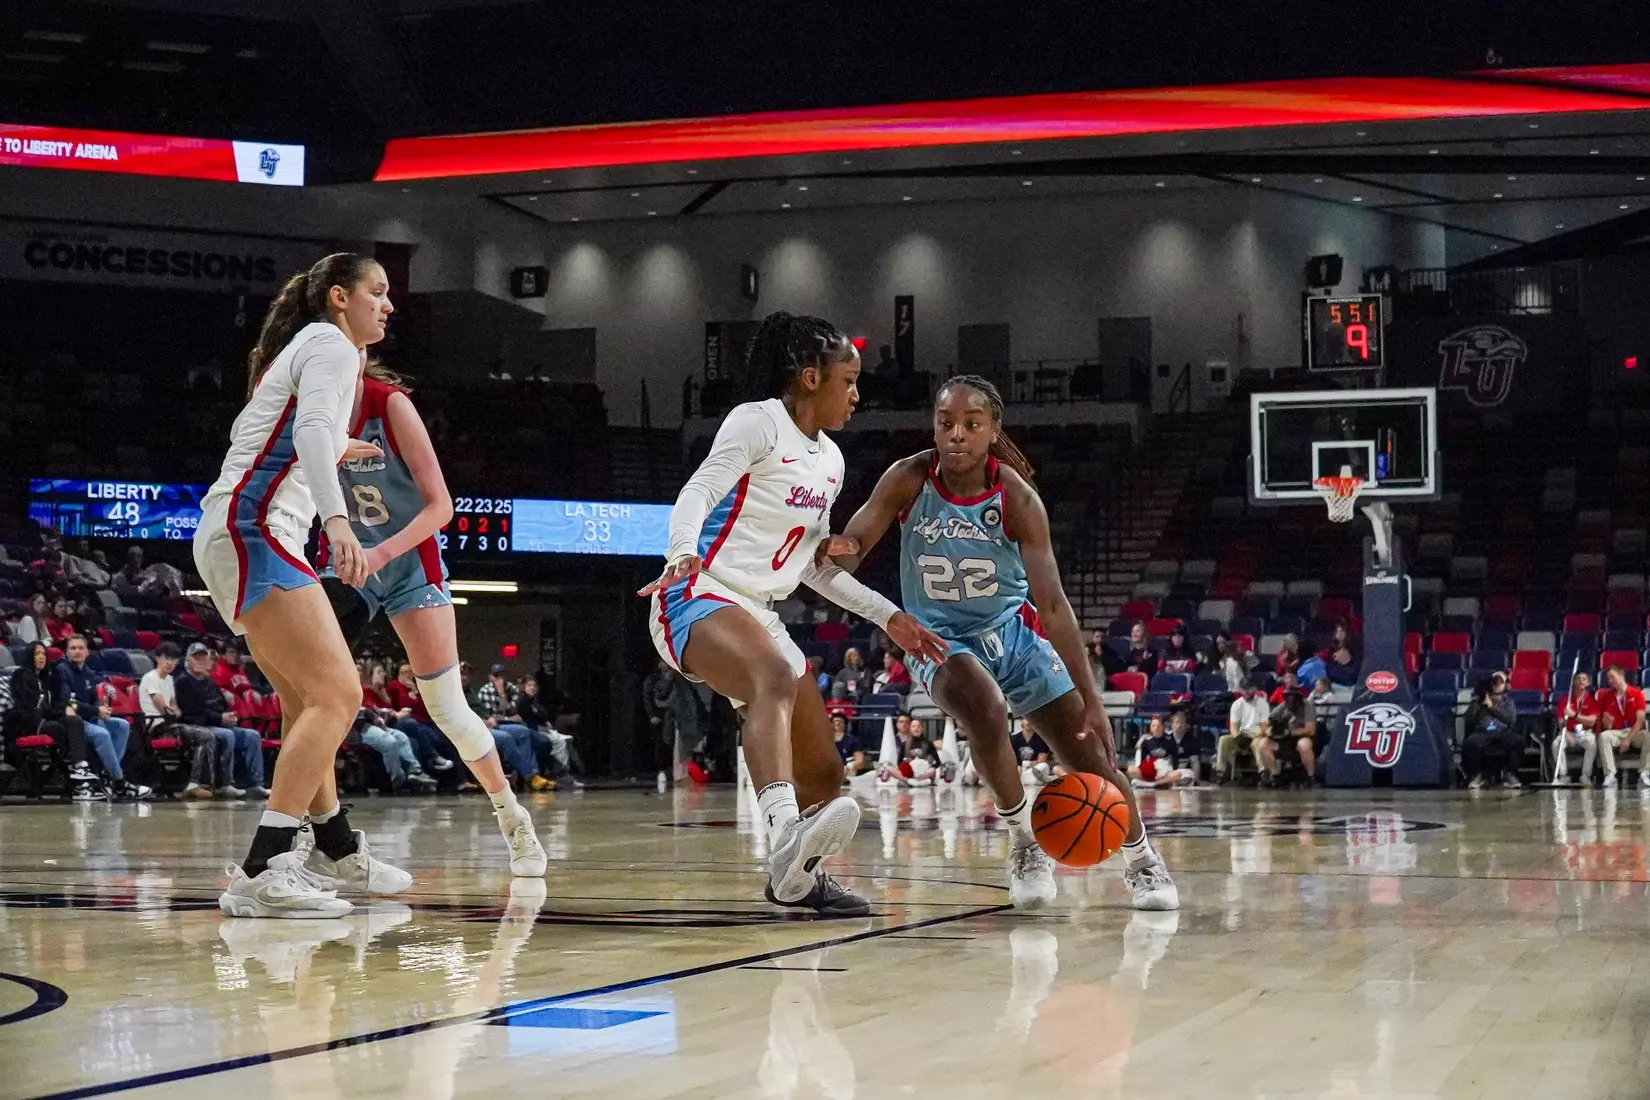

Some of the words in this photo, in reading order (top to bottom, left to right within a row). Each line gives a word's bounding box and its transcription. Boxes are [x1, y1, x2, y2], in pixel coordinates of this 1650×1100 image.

[4, 137, 20, 153] TO
[23, 139, 73, 157] LIBERTY
[75, 143, 118, 160] ARENA
[24, 240, 276, 283] CONCESSIONS
[1346, 324, 1368, 359] 9
[87, 483, 161, 500] LIBERTY
[108, 501, 140, 525] 48
[348, 484, 390, 527] 8
[475, 498, 493, 513] 23
[494, 499, 512, 514] 25
[565, 503, 584, 517] LA
[587, 504, 631, 518] TECH
[785, 486, 828, 521] Liberty
[141, 528, 149, 539] 0
[165, 517, 198, 529] POSS
[458, 517, 469, 532] 0
[478, 517, 489, 533] 2
[501, 519, 509, 533] 1
[583, 520, 612, 543] 33
[440, 534, 449, 550] 2
[458, 535, 468, 550] 7
[478, 536, 488, 551] 3
[498, 536, 508, 551] 0
[771, 526, 806, 571] 0
[917, 554, 1000, 601] 22
